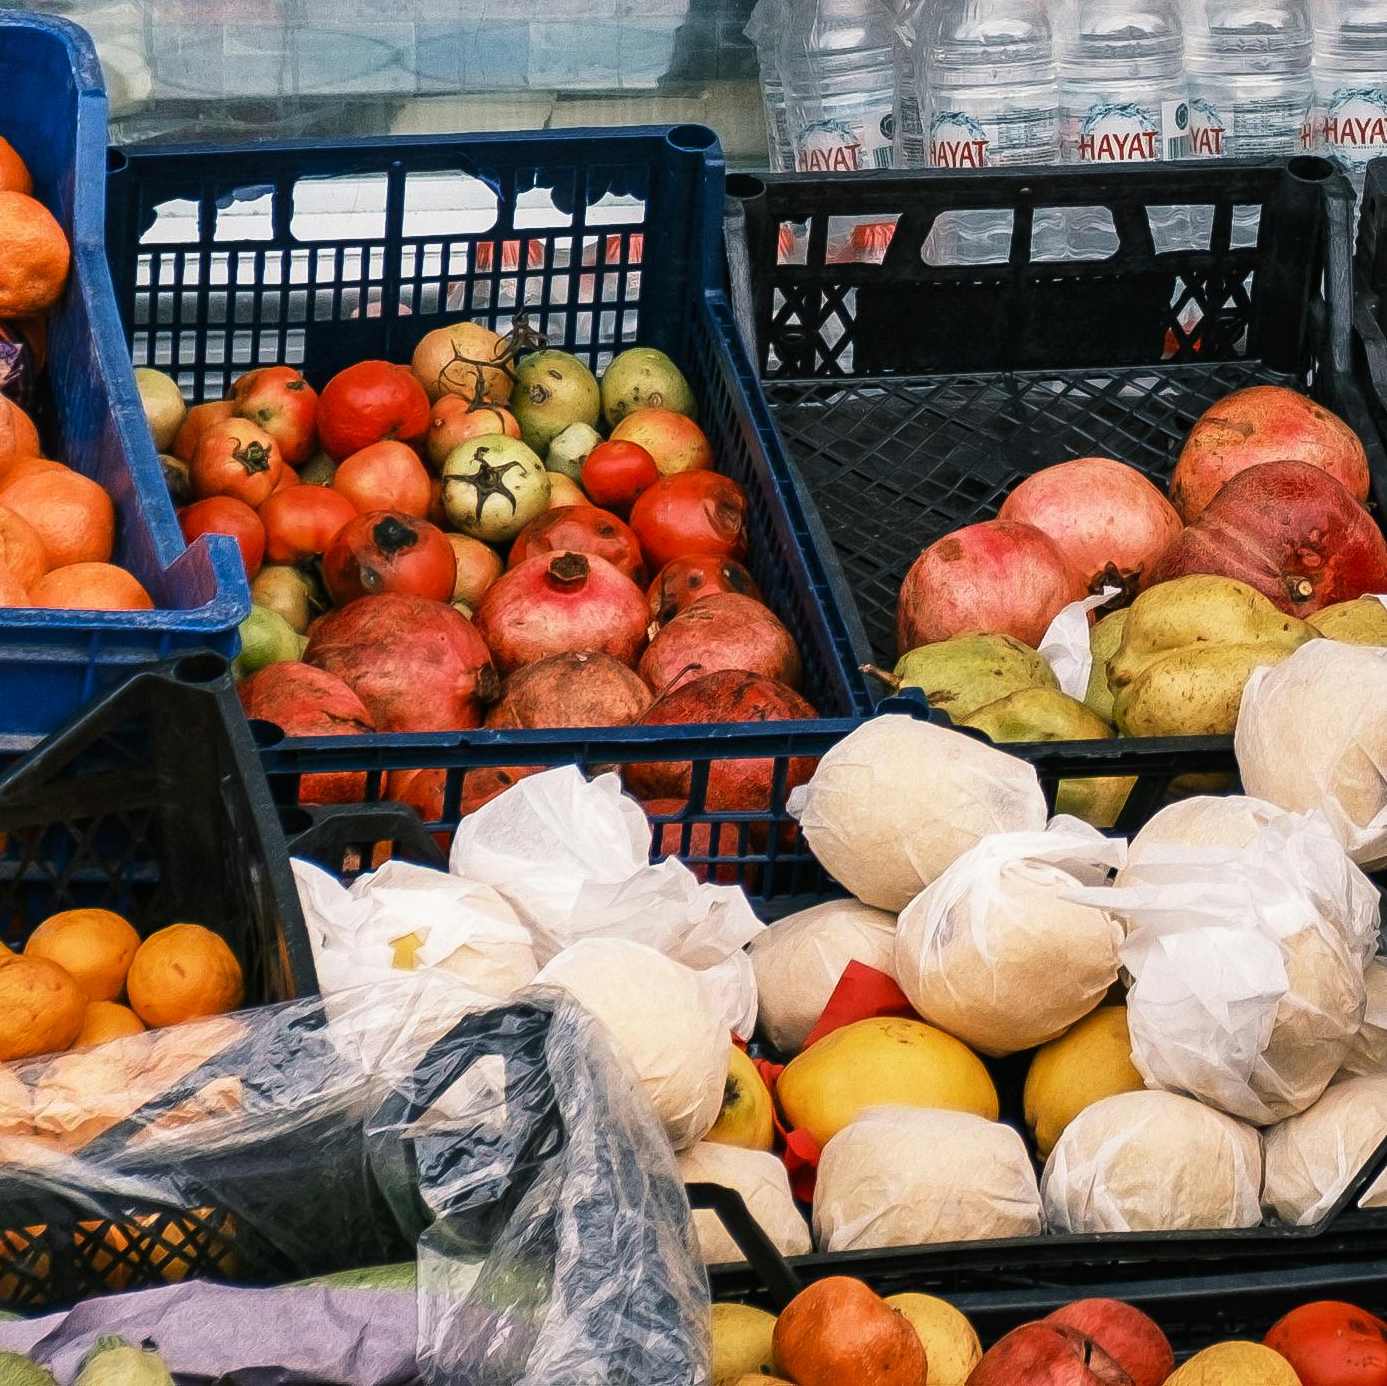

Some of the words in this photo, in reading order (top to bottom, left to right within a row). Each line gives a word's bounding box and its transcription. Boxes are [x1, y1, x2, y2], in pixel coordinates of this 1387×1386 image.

[1078, 130, 1160, 161] HAYAT
[1191, 127, 1227, 155] YAT
[798, 143, 862, 172] HAYAT
